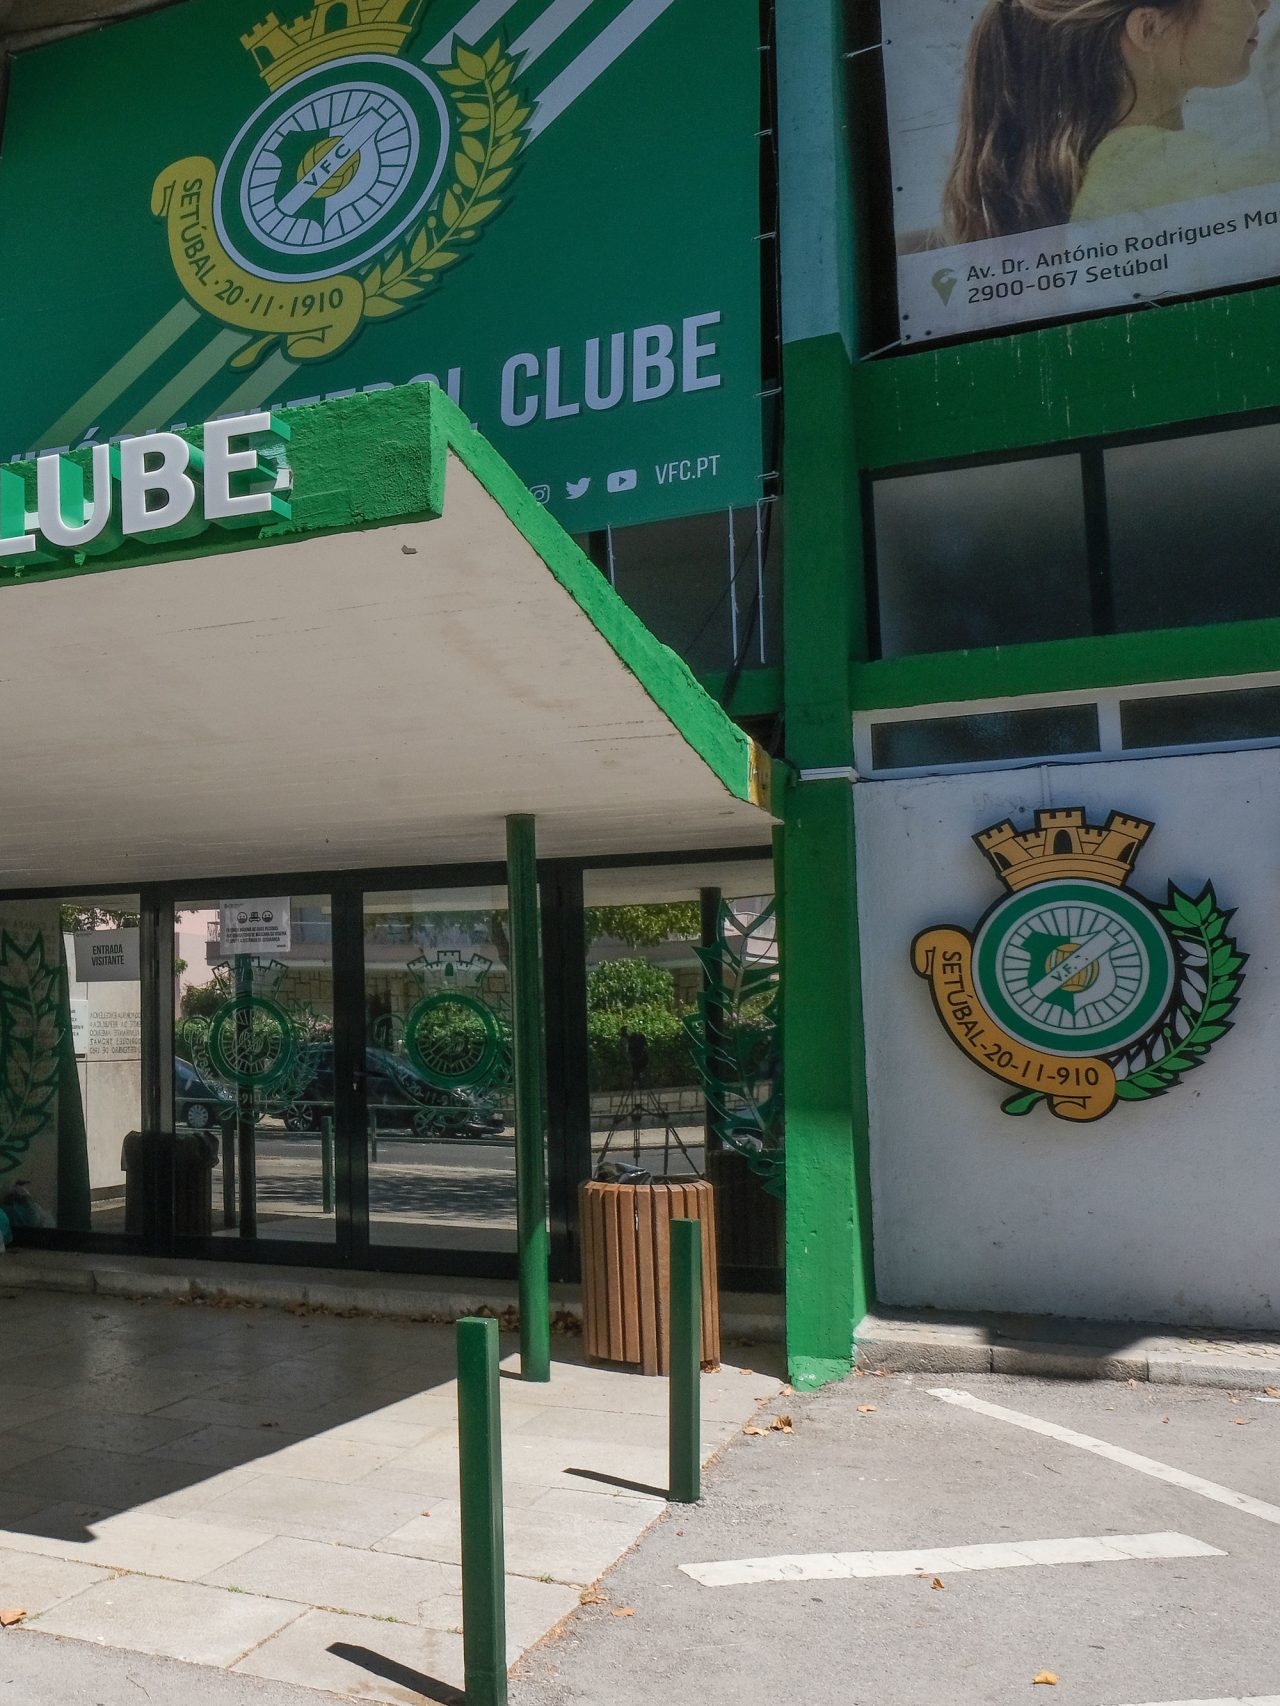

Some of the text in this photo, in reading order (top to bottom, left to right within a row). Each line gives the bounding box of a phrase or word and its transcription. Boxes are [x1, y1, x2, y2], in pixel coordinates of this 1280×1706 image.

[965, 209, 1280, 282] Av. Dr. António Rodrigues Ma
[967, 254, 1169, 304] 2900-067 Setúbal
[500, 310, 721, 427] CLUBE
[655, 454, 721, 486] VFC.PT
[91, 954, 125, 967] VISITANTE
[92, 943, 124, 956] ENTRADA
